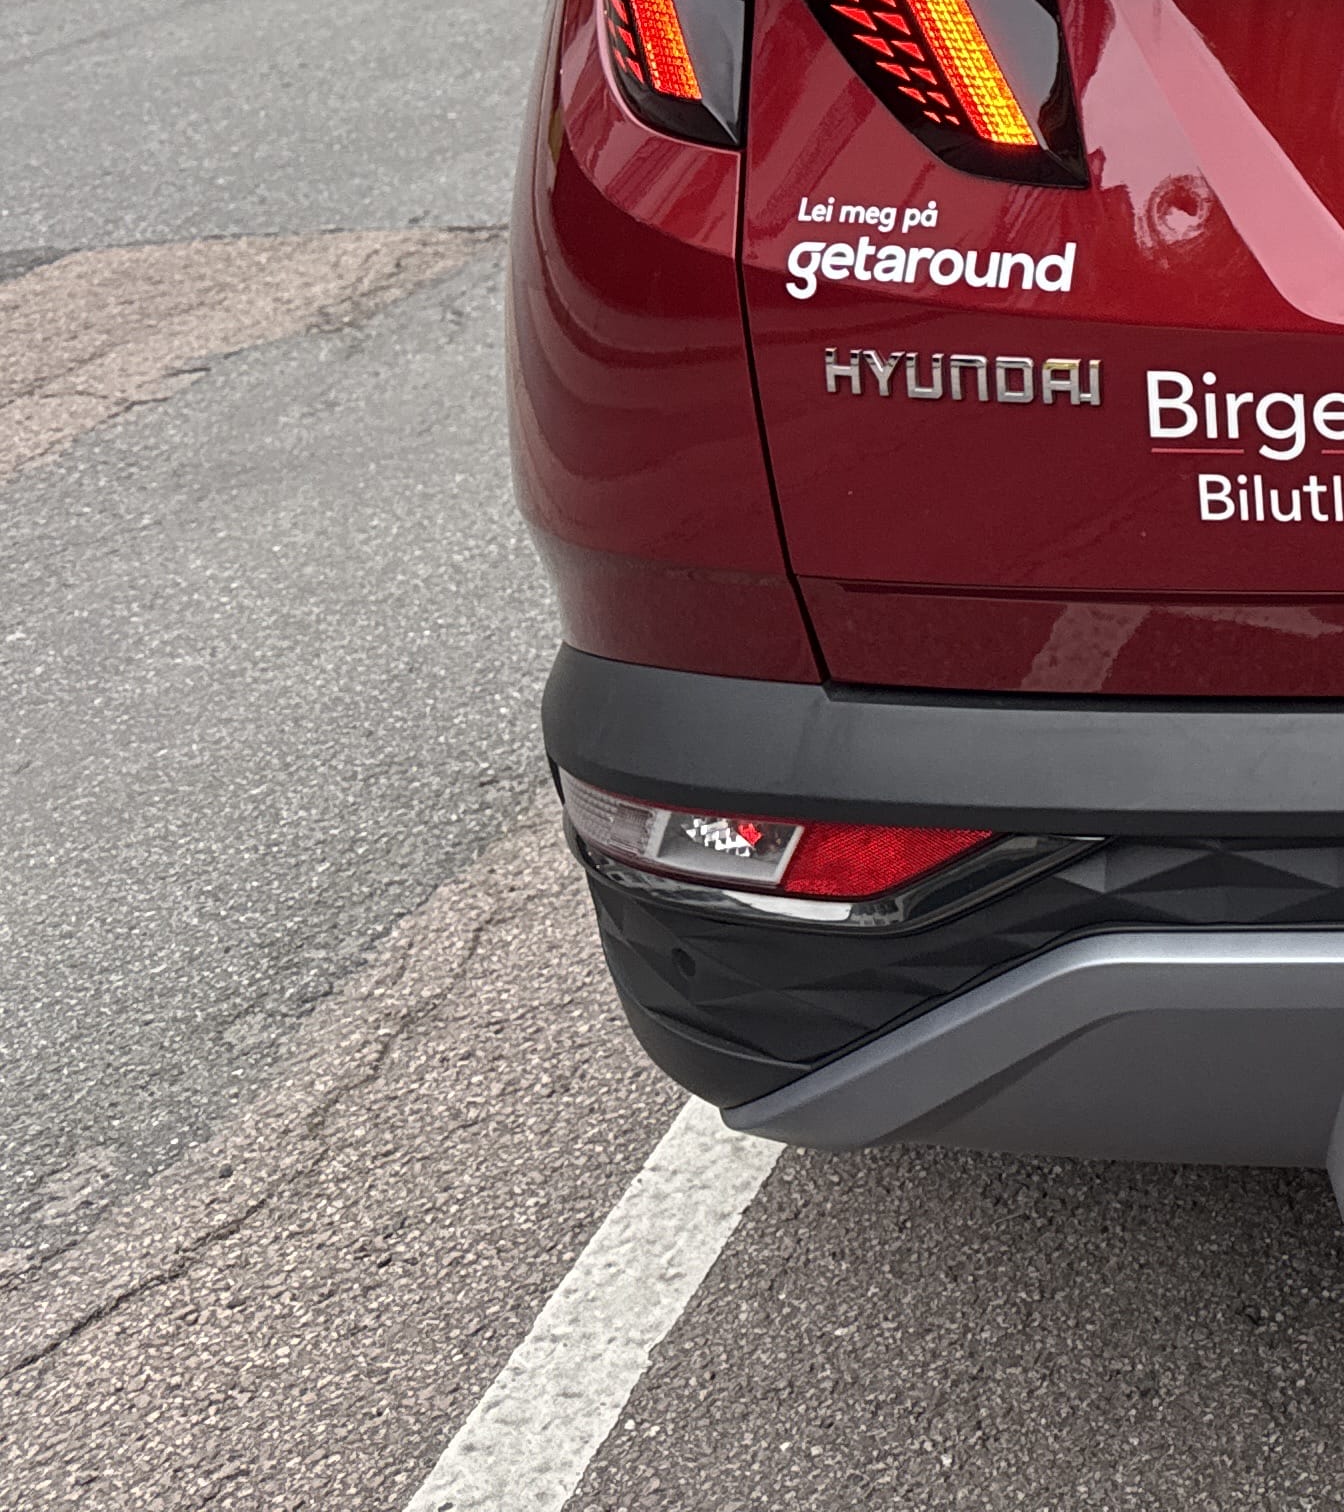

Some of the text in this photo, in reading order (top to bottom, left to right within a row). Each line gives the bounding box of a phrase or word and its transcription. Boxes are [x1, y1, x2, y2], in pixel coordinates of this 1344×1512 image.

[797, 196, 939, 233] Lei meg på
[785, 235, 1077, 300] getaround
[825, 347, 1101, 406] HYUNDAI
